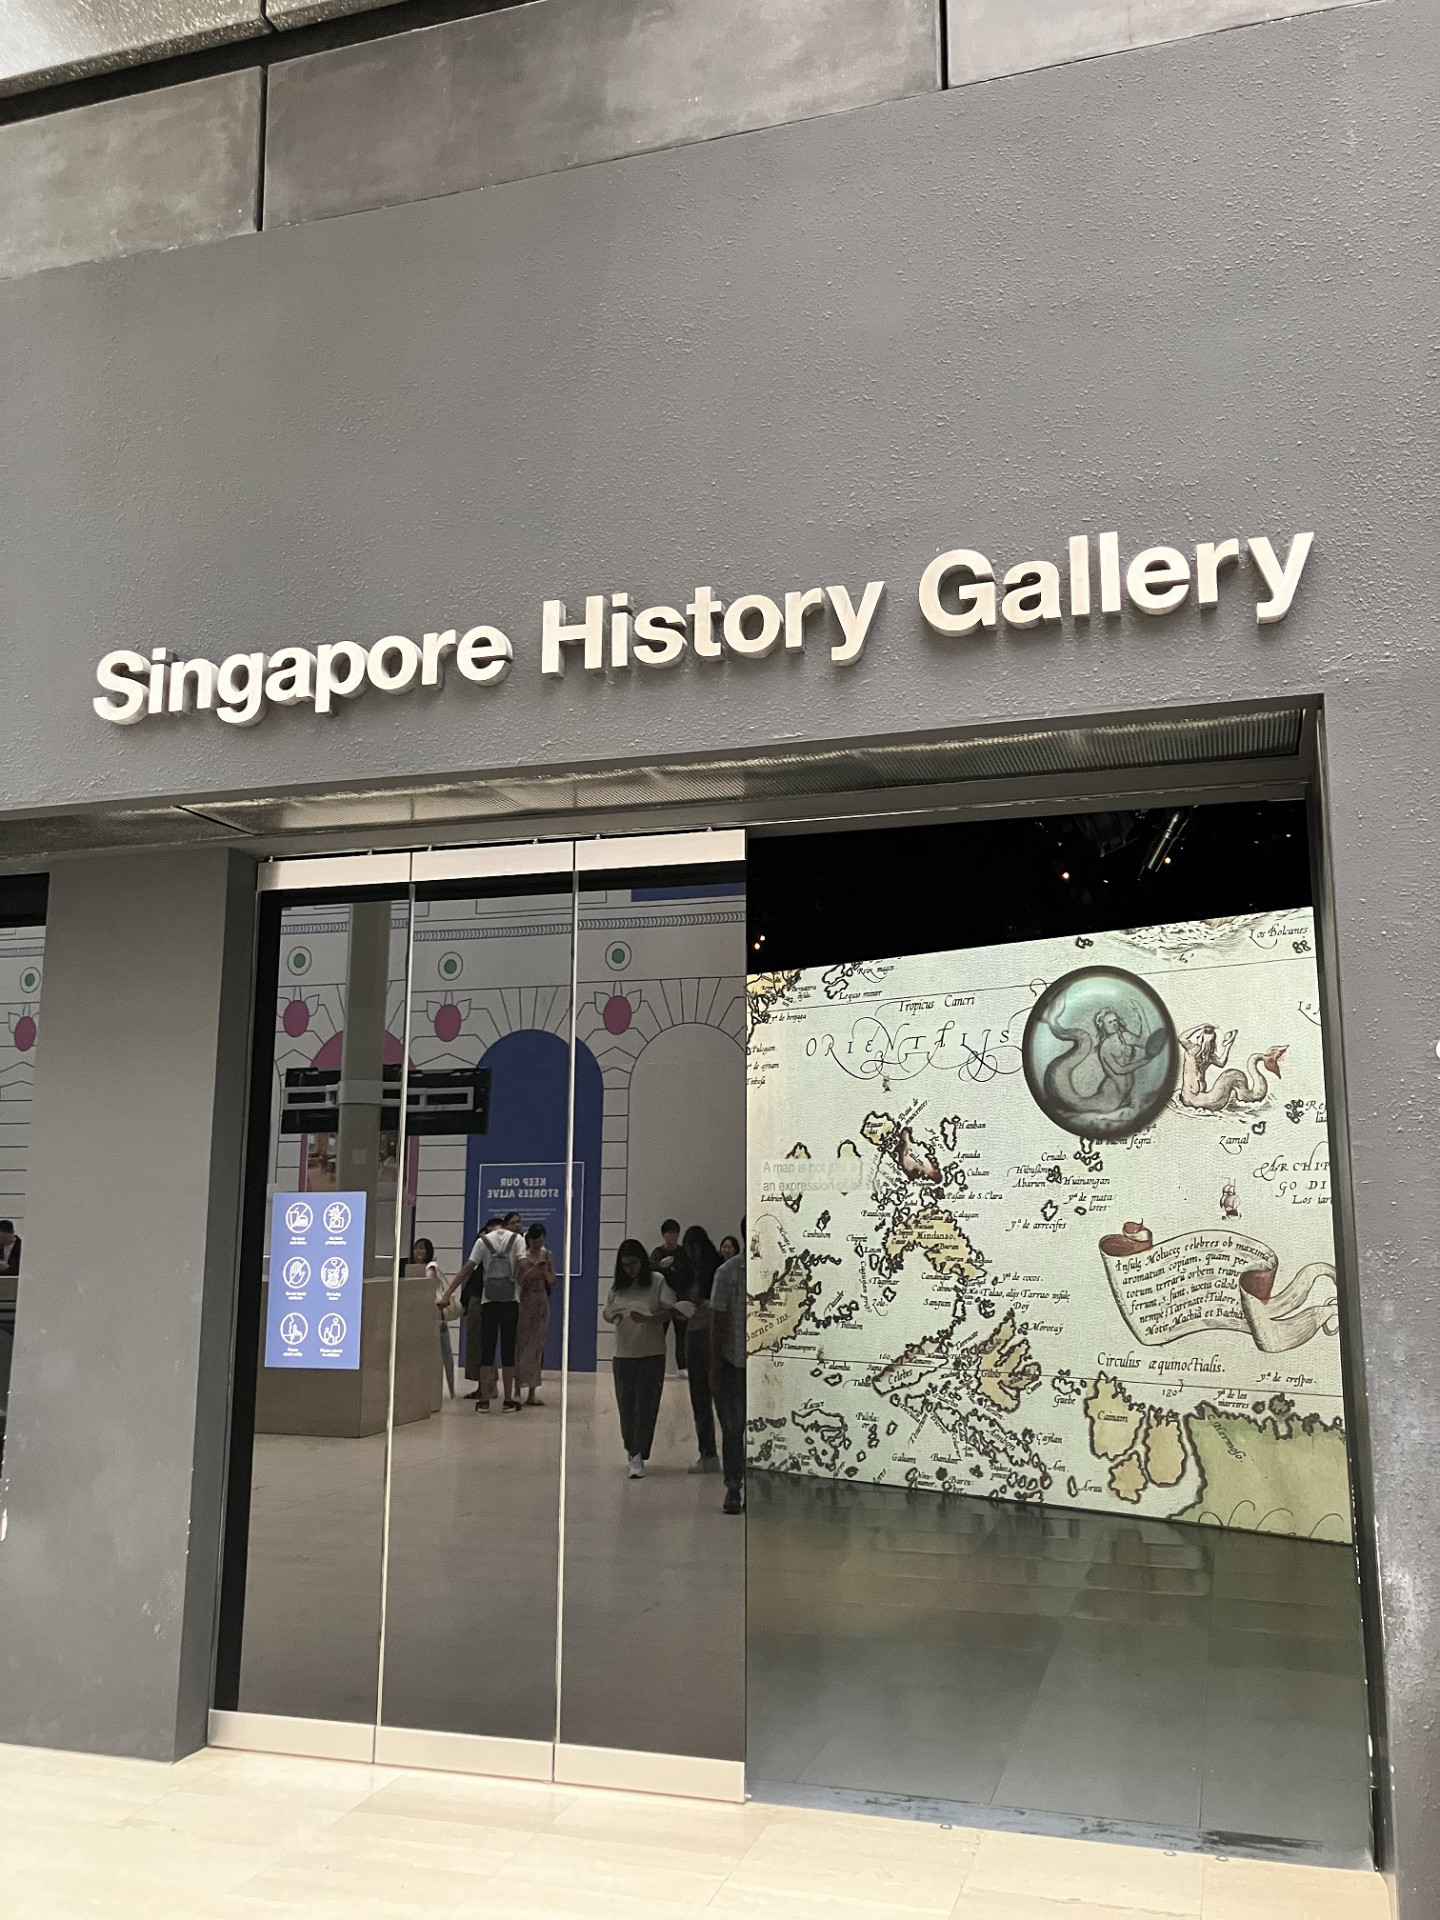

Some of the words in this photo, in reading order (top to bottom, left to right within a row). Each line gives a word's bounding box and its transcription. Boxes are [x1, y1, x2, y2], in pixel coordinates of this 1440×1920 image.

[93, 625, 513, 726] Singapore
[541, 580, 886, 678] History
[918, 531, 1314, 638] Gallery
[944, 993, 976, 1008] Cancri
[763, 1162, 771, 1173] A
[773, 1164, 795, 1176] map
[763, 1182, 776, 1191] an
[1097, 1351, 1142, 1368] Circulus
